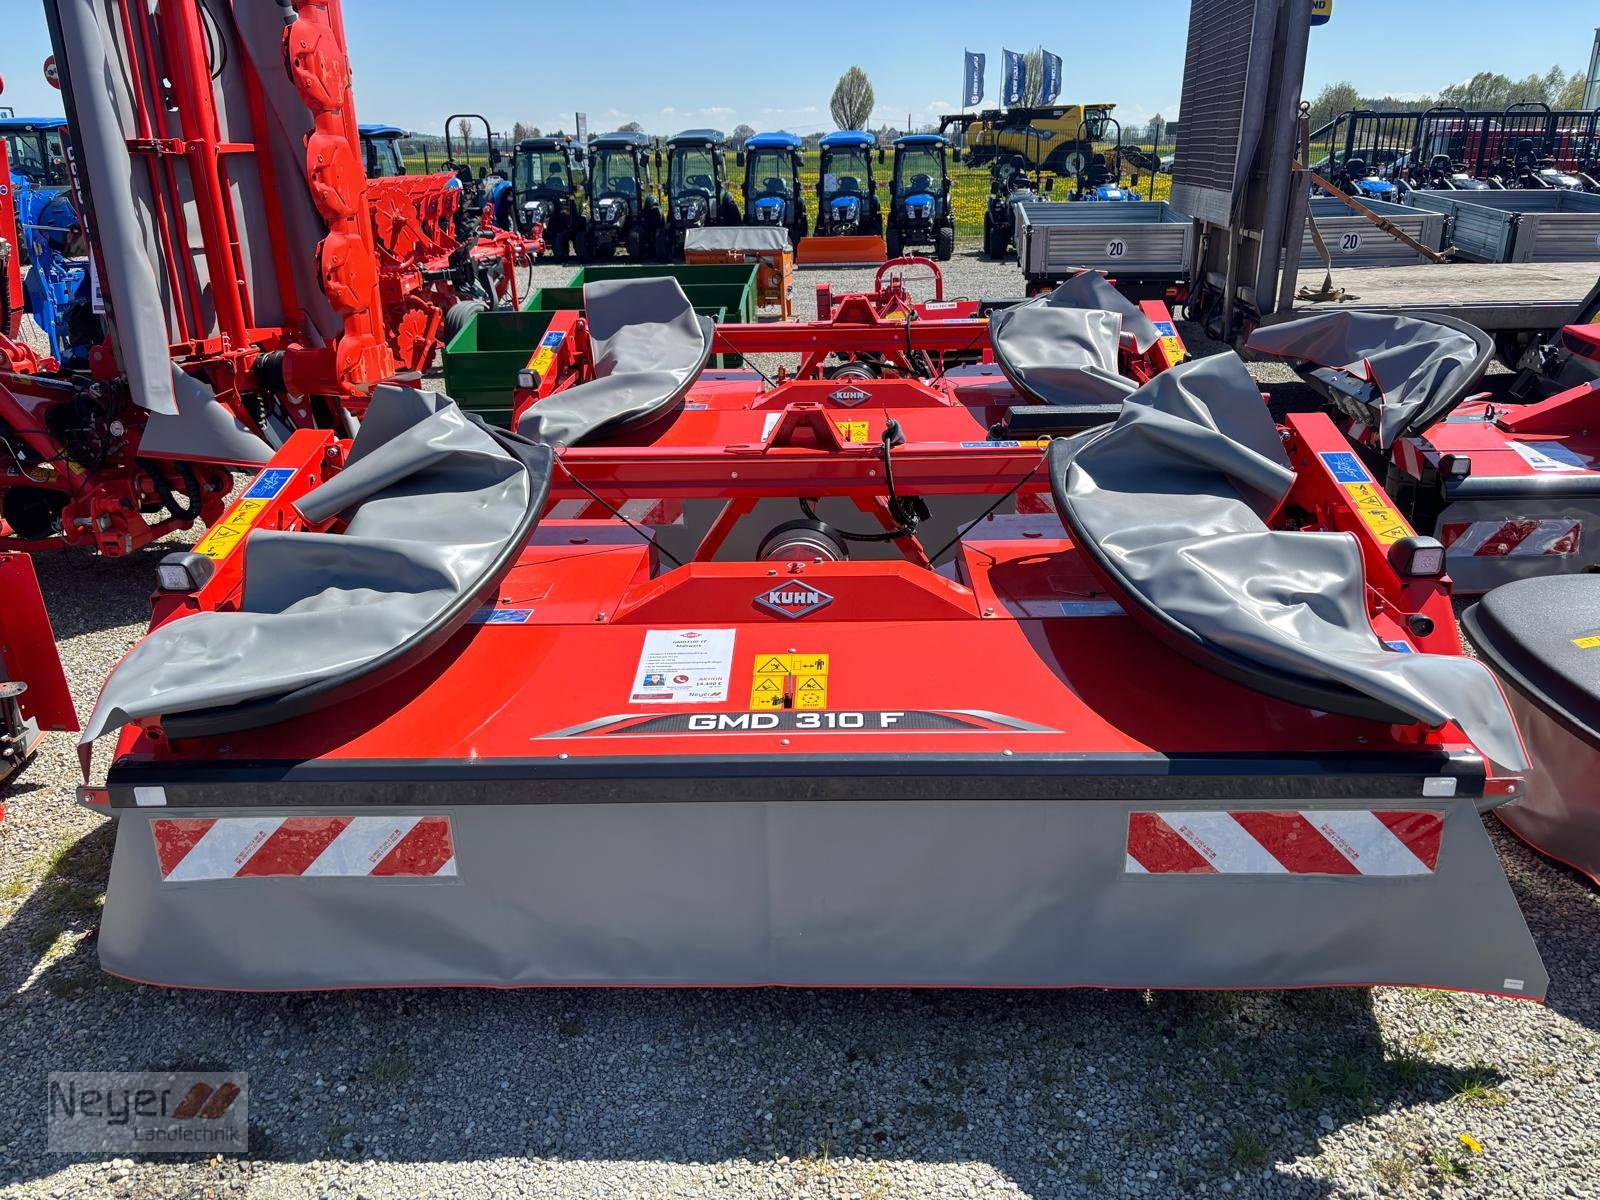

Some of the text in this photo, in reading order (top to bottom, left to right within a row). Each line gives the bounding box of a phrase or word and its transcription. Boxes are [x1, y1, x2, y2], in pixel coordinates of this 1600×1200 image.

[1343, 234, 1358, 249] 20
[1109, 242, 1123, 256] 20
[769, 592, 819, 604] KUHN
[688, 712, 905, 730] GMD 310 F
